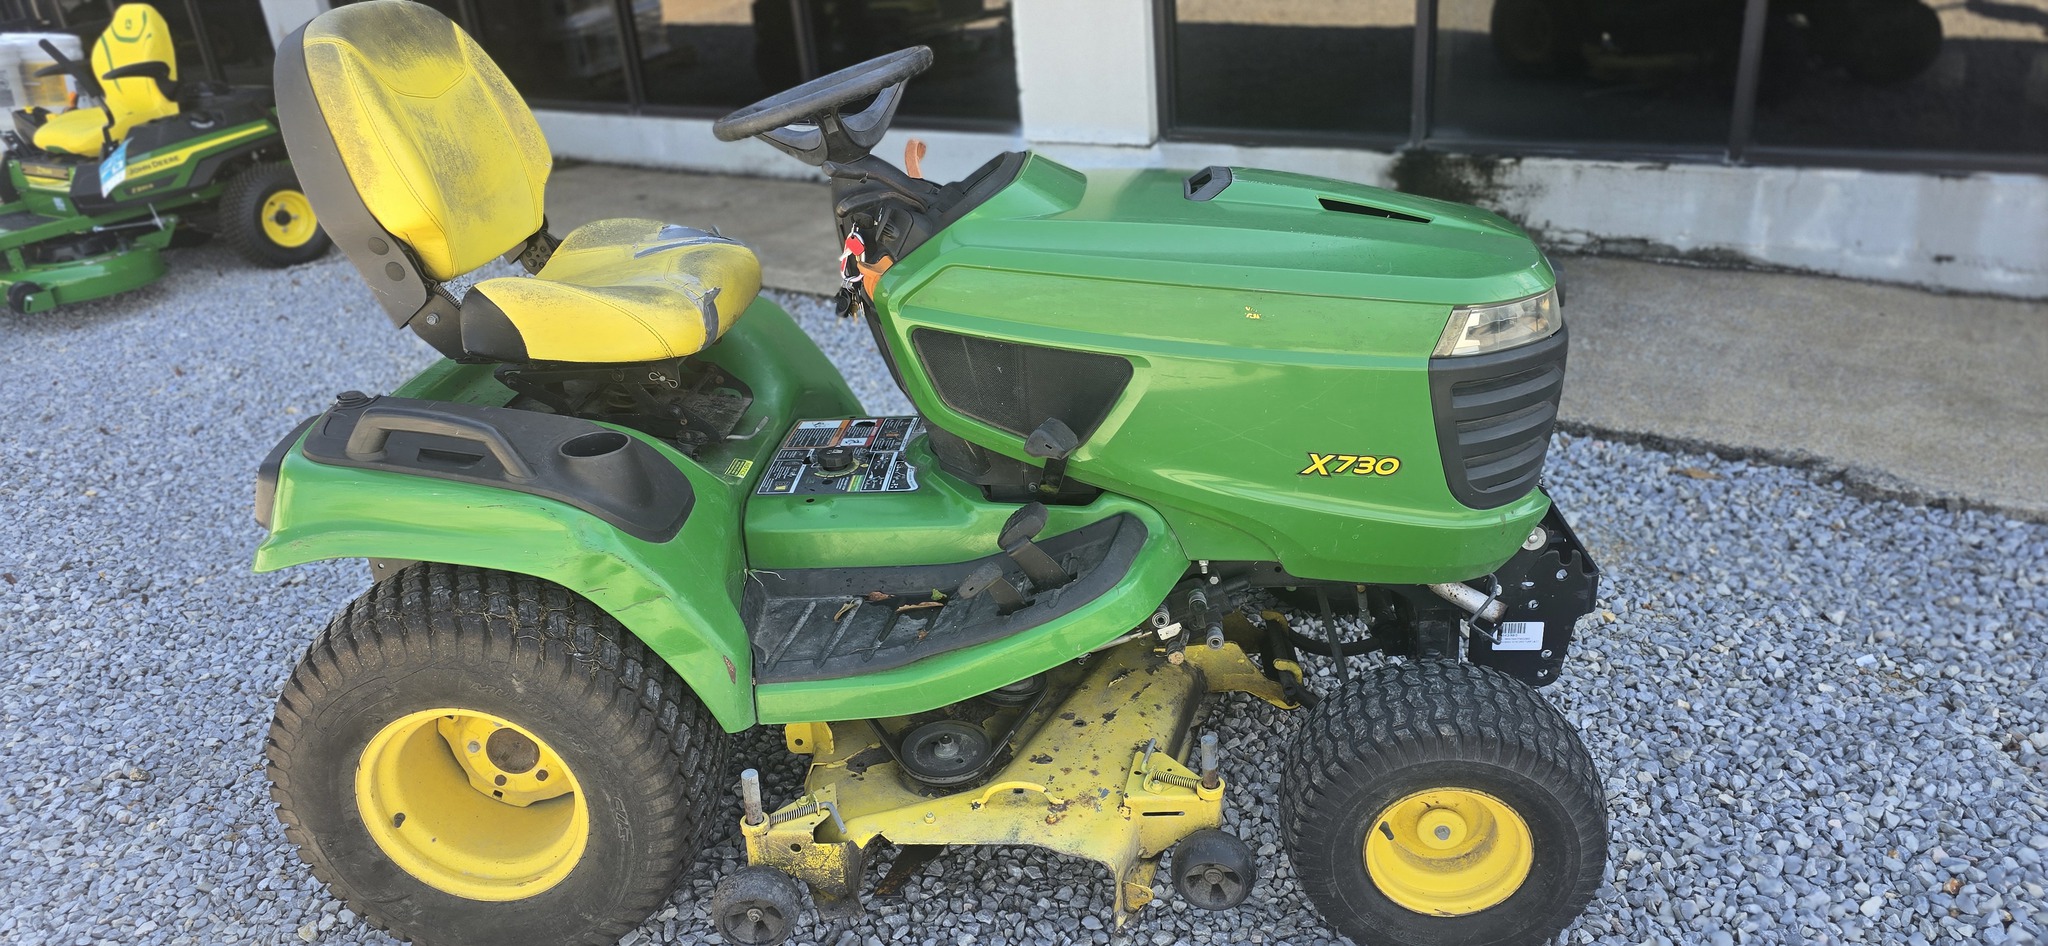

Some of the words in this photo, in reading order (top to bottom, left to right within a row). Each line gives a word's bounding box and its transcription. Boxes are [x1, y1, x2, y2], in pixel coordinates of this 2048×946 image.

[128, 164, 152, 176] JOHN
[151, 155, 180, 168] DEERE
[1297, 452, 1402, 478] X730
